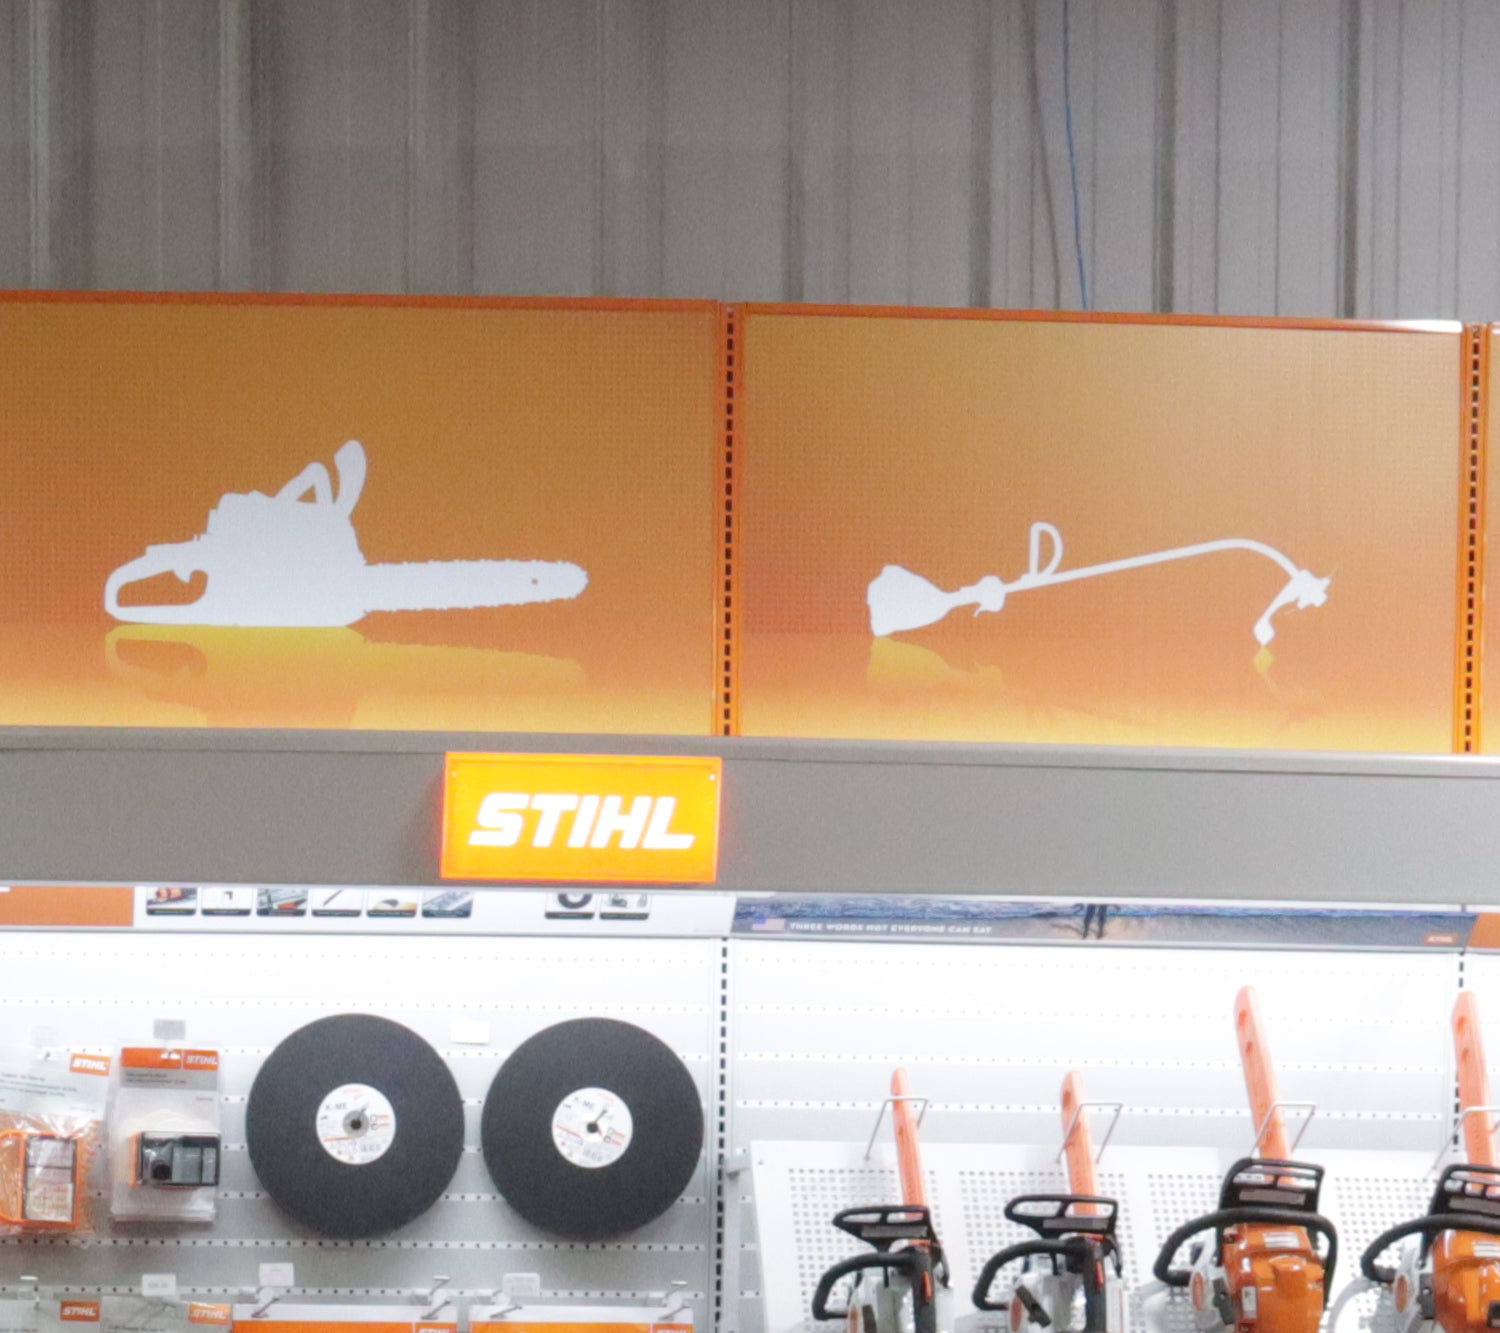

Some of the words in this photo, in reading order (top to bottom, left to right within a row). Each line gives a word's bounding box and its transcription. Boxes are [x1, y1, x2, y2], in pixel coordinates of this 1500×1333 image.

[468, 793, 695, 849] STIHL
[186, 1054, 219, 1065] STIHL
[62, 1306, 97, 1317] STIHL
